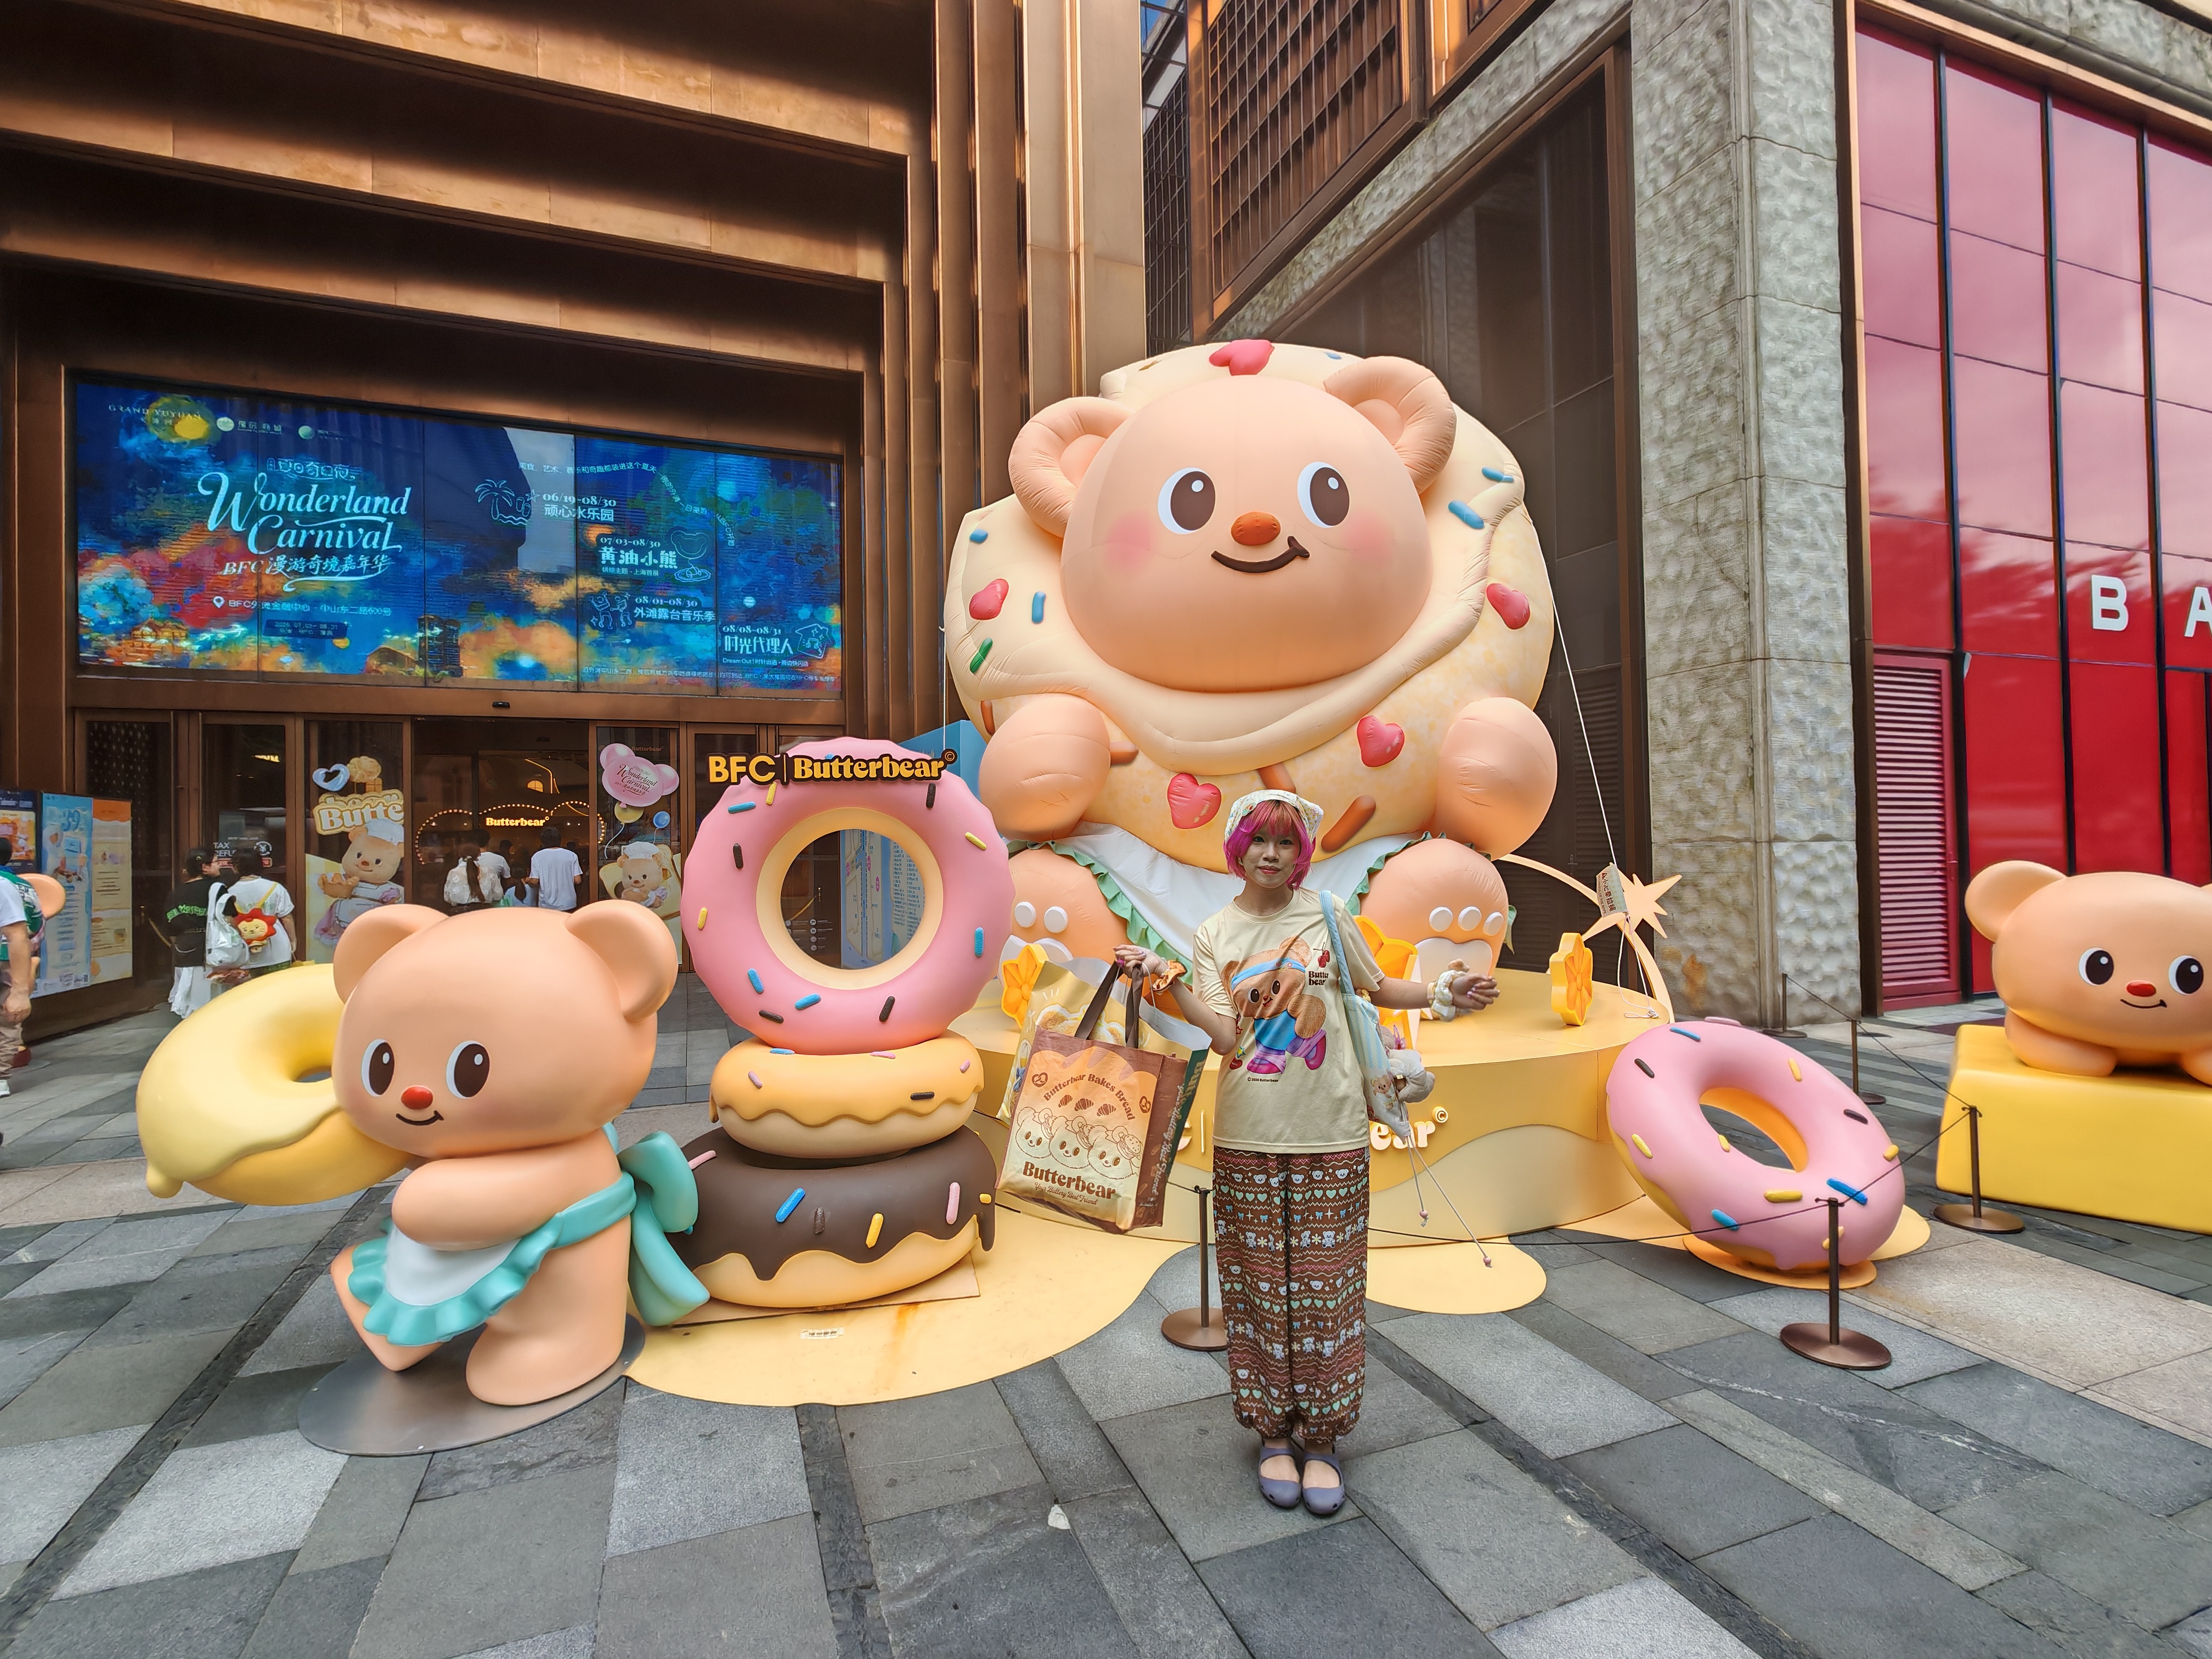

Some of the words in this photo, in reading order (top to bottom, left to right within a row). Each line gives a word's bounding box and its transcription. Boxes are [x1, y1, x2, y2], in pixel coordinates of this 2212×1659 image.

[198, 472, 411, 532] Wonderland
[543, 493, 617, 507] 06/19-08/30
[544, 503, 614, 523] 顽心水乐园
[247, 515, 403, 555] Carnival
[600, 536, 661, 548] 07/03-08/30
[599, 546, 678, 569] 黄油小熊
[635, 596, 698, 608] 08/01-08/30
[633, 607, 716, 622] 外滩露台音乐季
[724, 635, 794, 655] 时光代理人
[617, 764, 658, 786] Wonderland
[708, 755, 775, 783] BFC
[621, 775, 650, 793] Carnival
[1043, 1074, 1086, 1101] Butterbear
[1087, 1073, 1116, 1092] Bakes
[1115, 1090, 1136, 1120] Bread
[1023, 1161, 1116, 1199] Butterbear
[1035, 1182, 1047, 1190] Your
[1048, 1186, 1067, 1198] Buttery
[1067, 1191, 1079, 1200] Best
[1079, 1194, 1098, 1205] Friend
